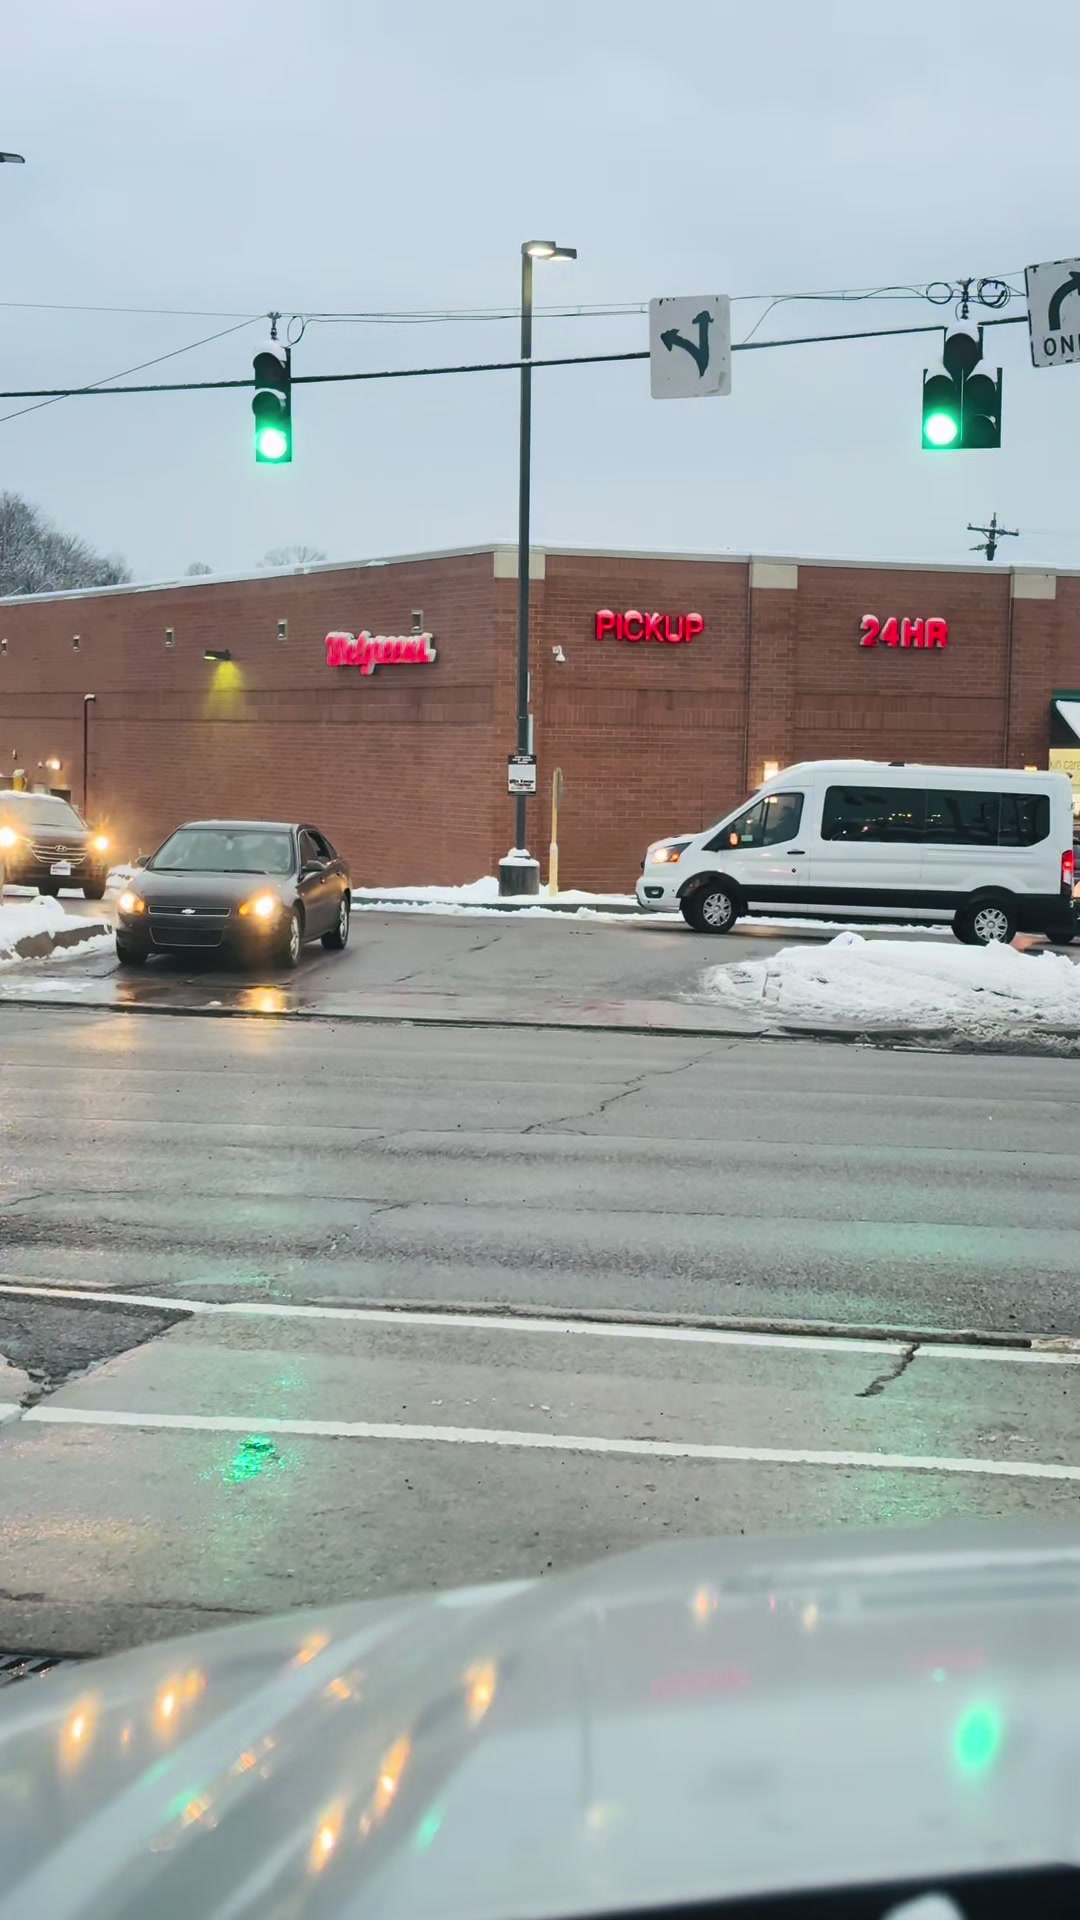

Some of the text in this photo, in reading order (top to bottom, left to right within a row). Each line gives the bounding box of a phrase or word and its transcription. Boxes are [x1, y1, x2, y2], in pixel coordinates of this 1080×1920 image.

[1044, 334, 1080, 356] ON
[596, 609, 704, 643] PICKUP
[859, 614, 948, 648] 24HR
